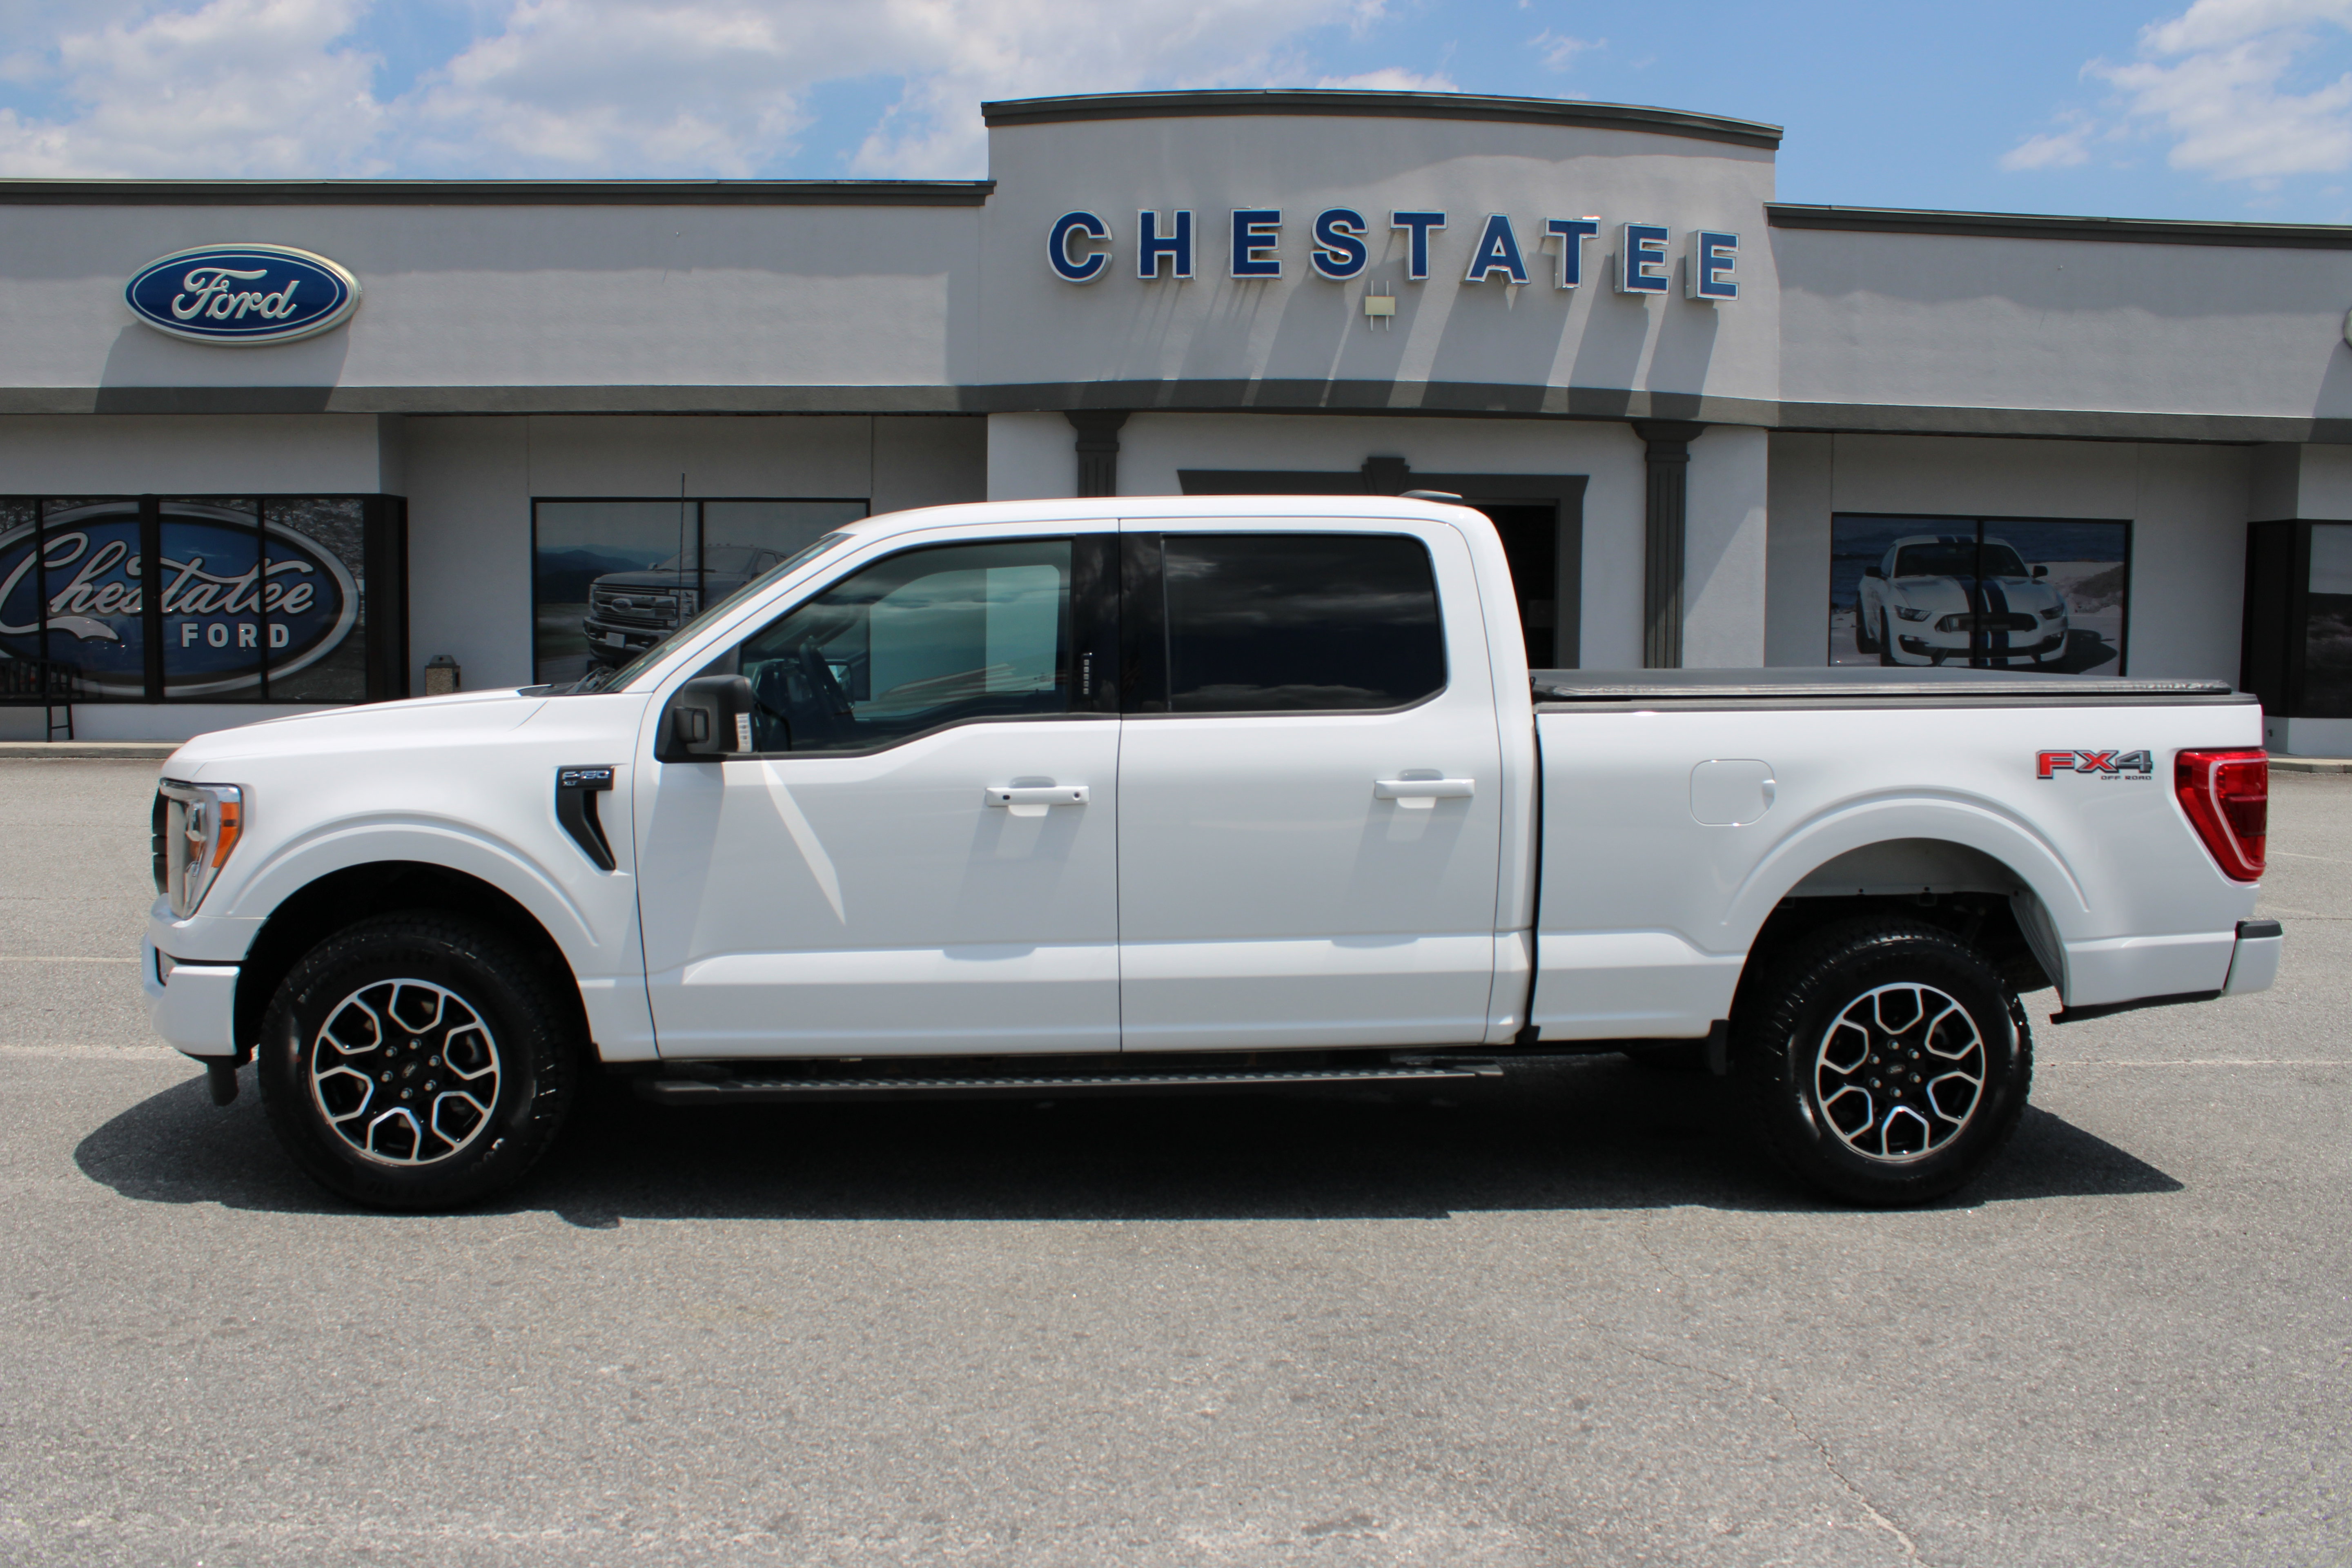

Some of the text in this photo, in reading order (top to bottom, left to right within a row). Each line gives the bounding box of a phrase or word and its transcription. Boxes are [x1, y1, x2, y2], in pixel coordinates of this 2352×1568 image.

[1045, 206, 1741, 301] CHESTATEE
[172, 267, 299, 320] Ford
[182, 624, 290, 648] FORD
[562, 770, 610, 780] F-150
[2036, 750, 2152, 779] FX4
